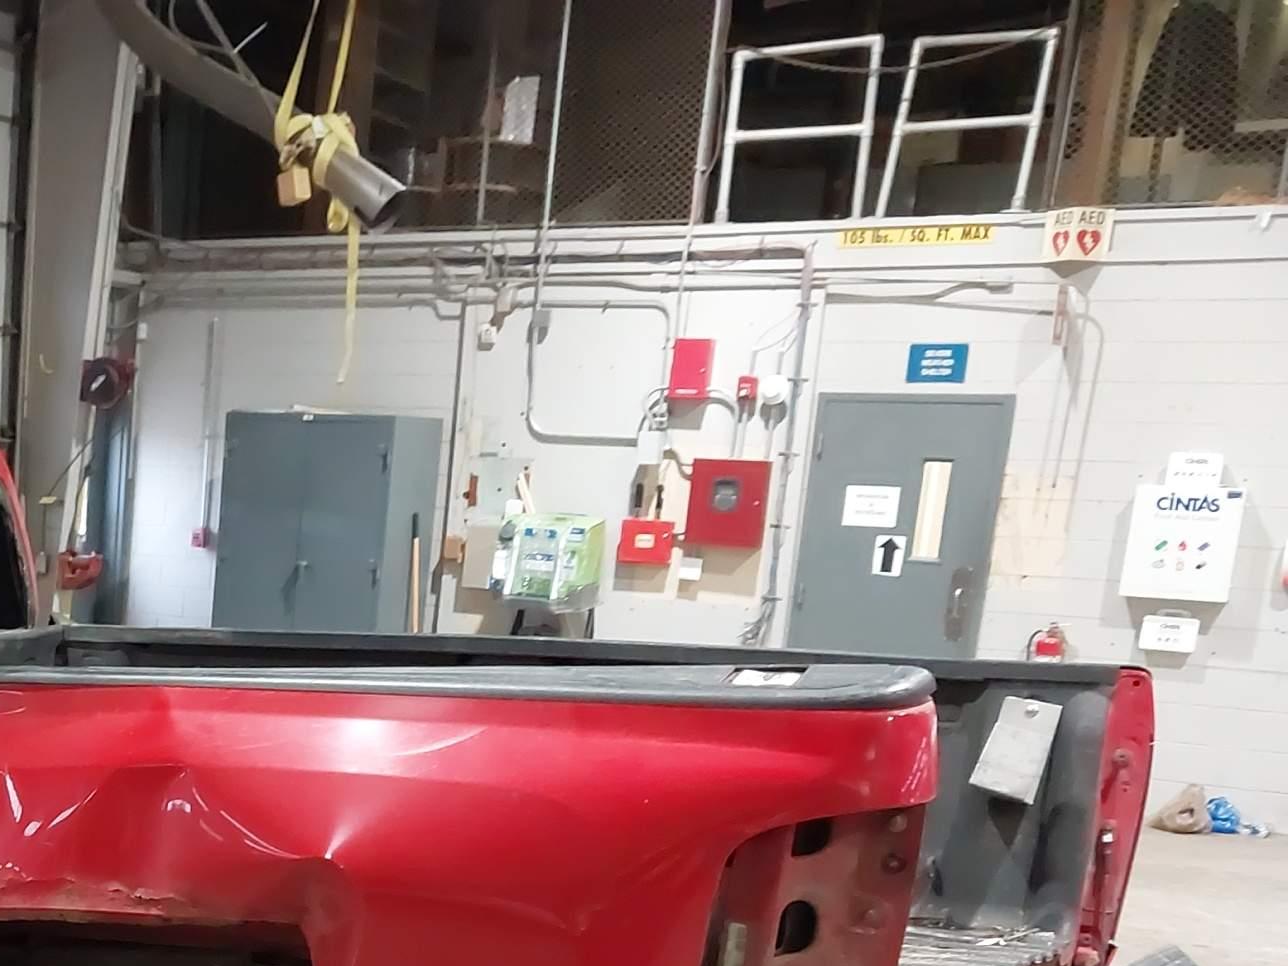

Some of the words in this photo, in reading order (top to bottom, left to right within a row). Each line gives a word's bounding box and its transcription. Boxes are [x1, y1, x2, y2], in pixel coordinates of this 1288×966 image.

[1055, 211, 1073, 225] AED
[1078, 210, 1106, 225] AED
[843, 229, 866, 244] 105
[871, 229, 893, 244] lbs.
[909, 228, 930, 243] SQ.
[935, 227, 954, 242] FT.
[960, 225, 992, 241] MAX
